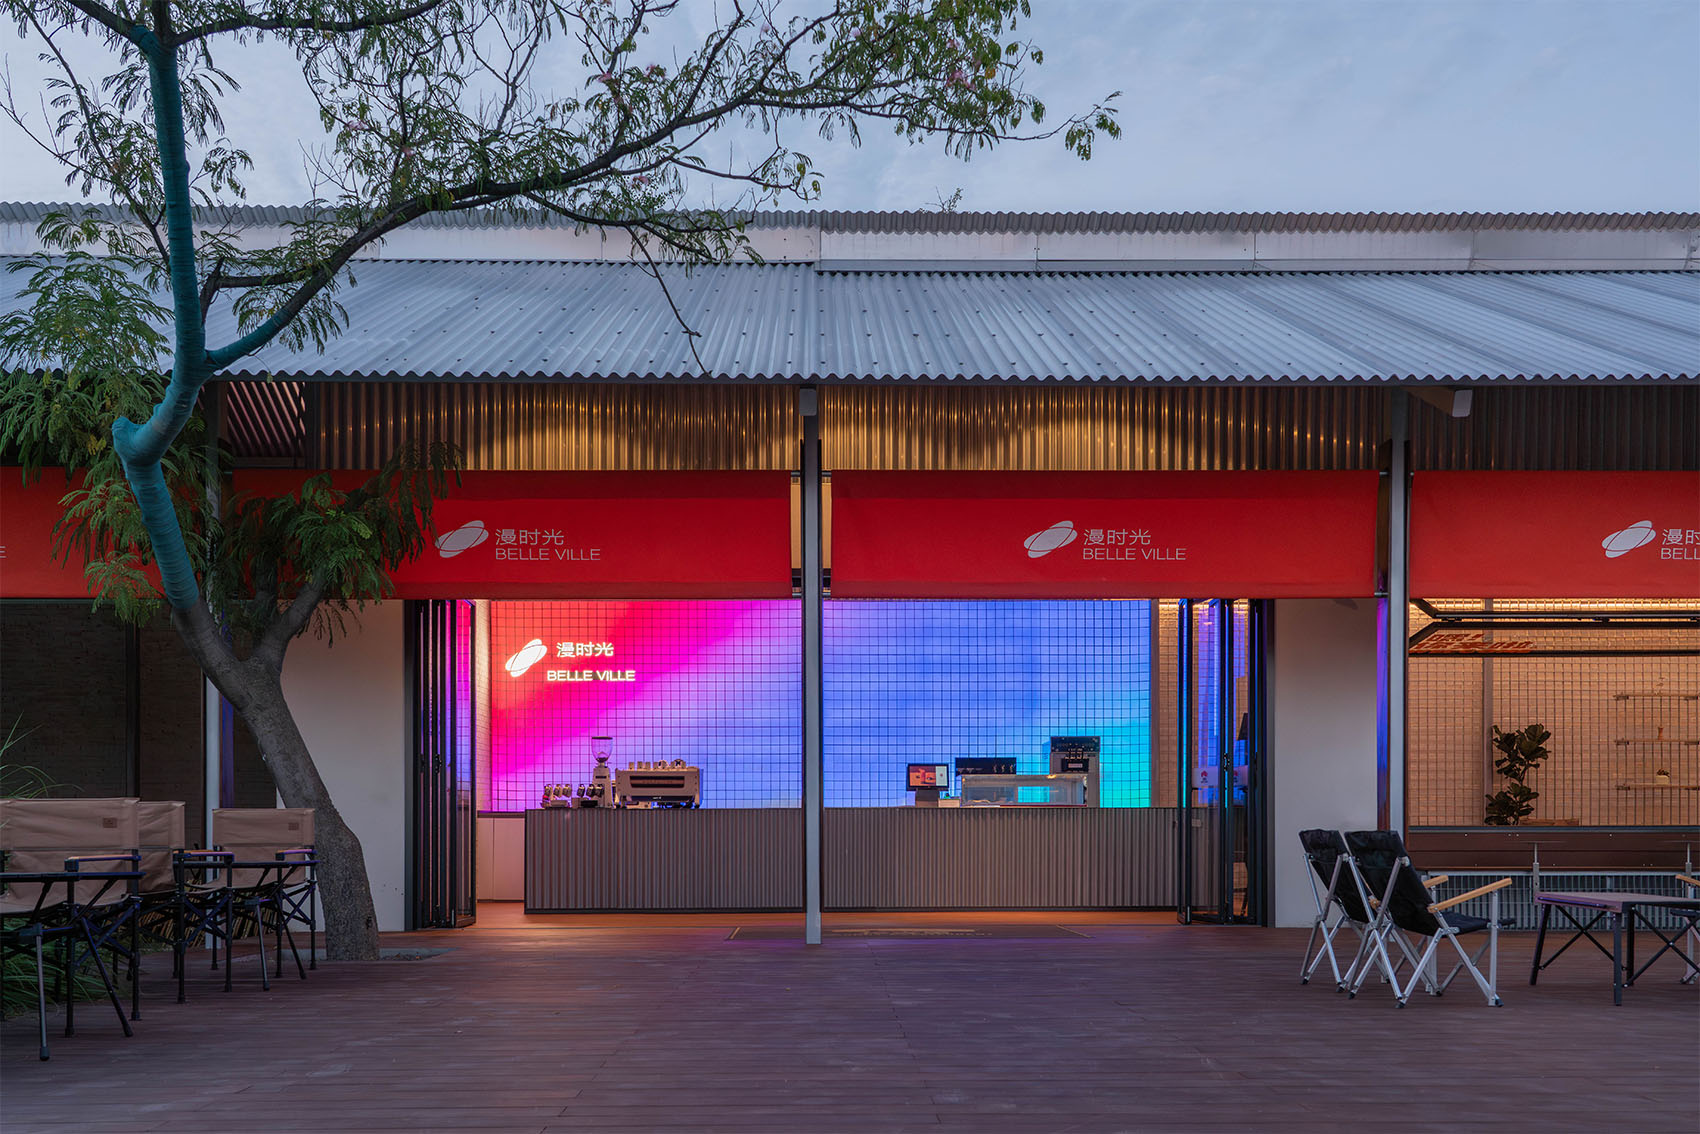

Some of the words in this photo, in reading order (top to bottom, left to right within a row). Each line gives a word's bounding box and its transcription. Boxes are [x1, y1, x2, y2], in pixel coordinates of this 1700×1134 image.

[495, 529, 564, 545] 漫时光
[1083, 529, 1151, 545] 漫时光
[495, 548, 550, 560] BELLE
[554, 548, 600, 560] VILLE
[1082, 548, 1136, 560] BELLE
[1141, 548, 1186, 560] VILLE
[556, 641, 614, 657] 漫时光
[547, 670, 593, 681] BELLE
[596, 670, 636, 681] VILLE
